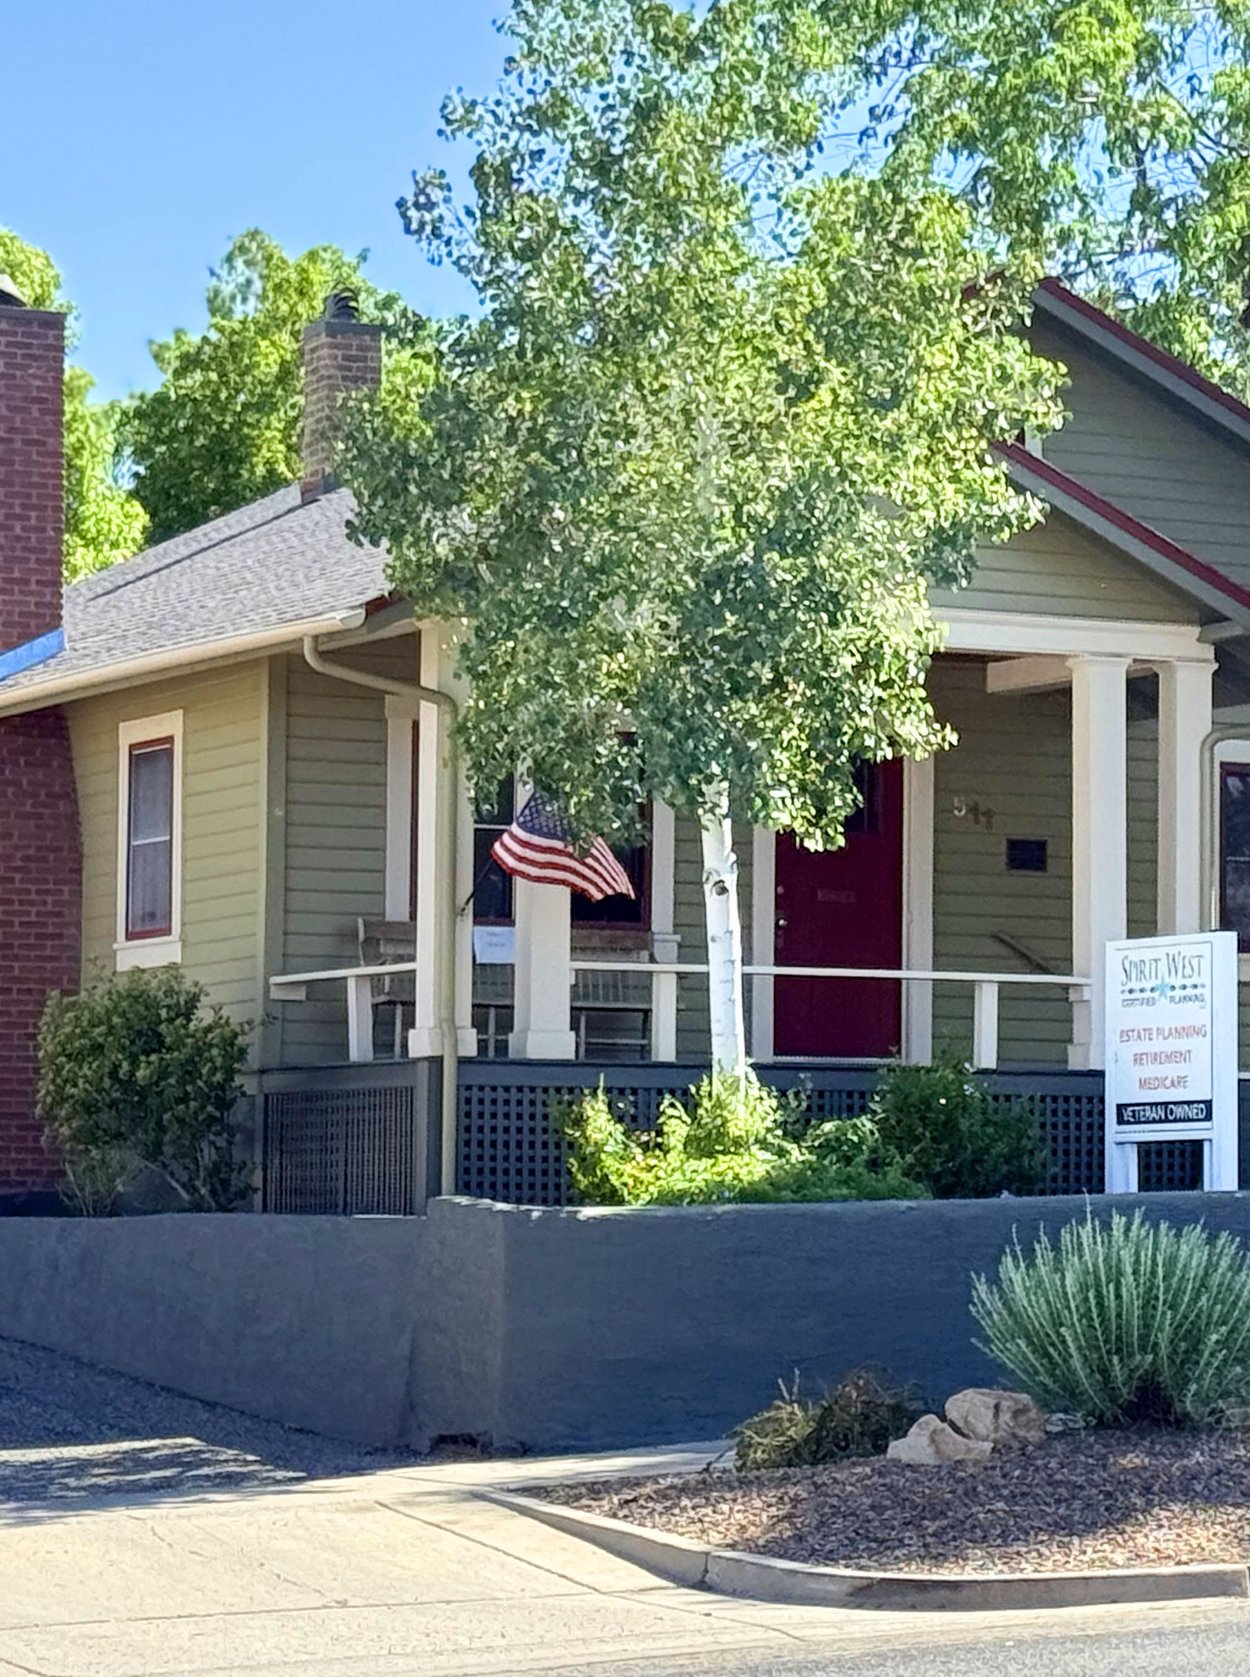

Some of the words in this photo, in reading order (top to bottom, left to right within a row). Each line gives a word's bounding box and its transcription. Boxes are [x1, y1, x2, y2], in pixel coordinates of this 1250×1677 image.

[1121, 955, 1162, 986] SPIRIT
[1166, 951, 1204, 980] WEST
[1119, 1028, 1154, 1043] ESTATE
[1156, 1024, 1207, 1040] PLANNING
[1133, 1050, 1193, 1067] RETIREMENT
[1138, 1075, 1189, 1090] MEDICARE
[1122, 1106, 1165, 1122] VETERAN
[1167, 1103, 1207, 1119] OWNED
